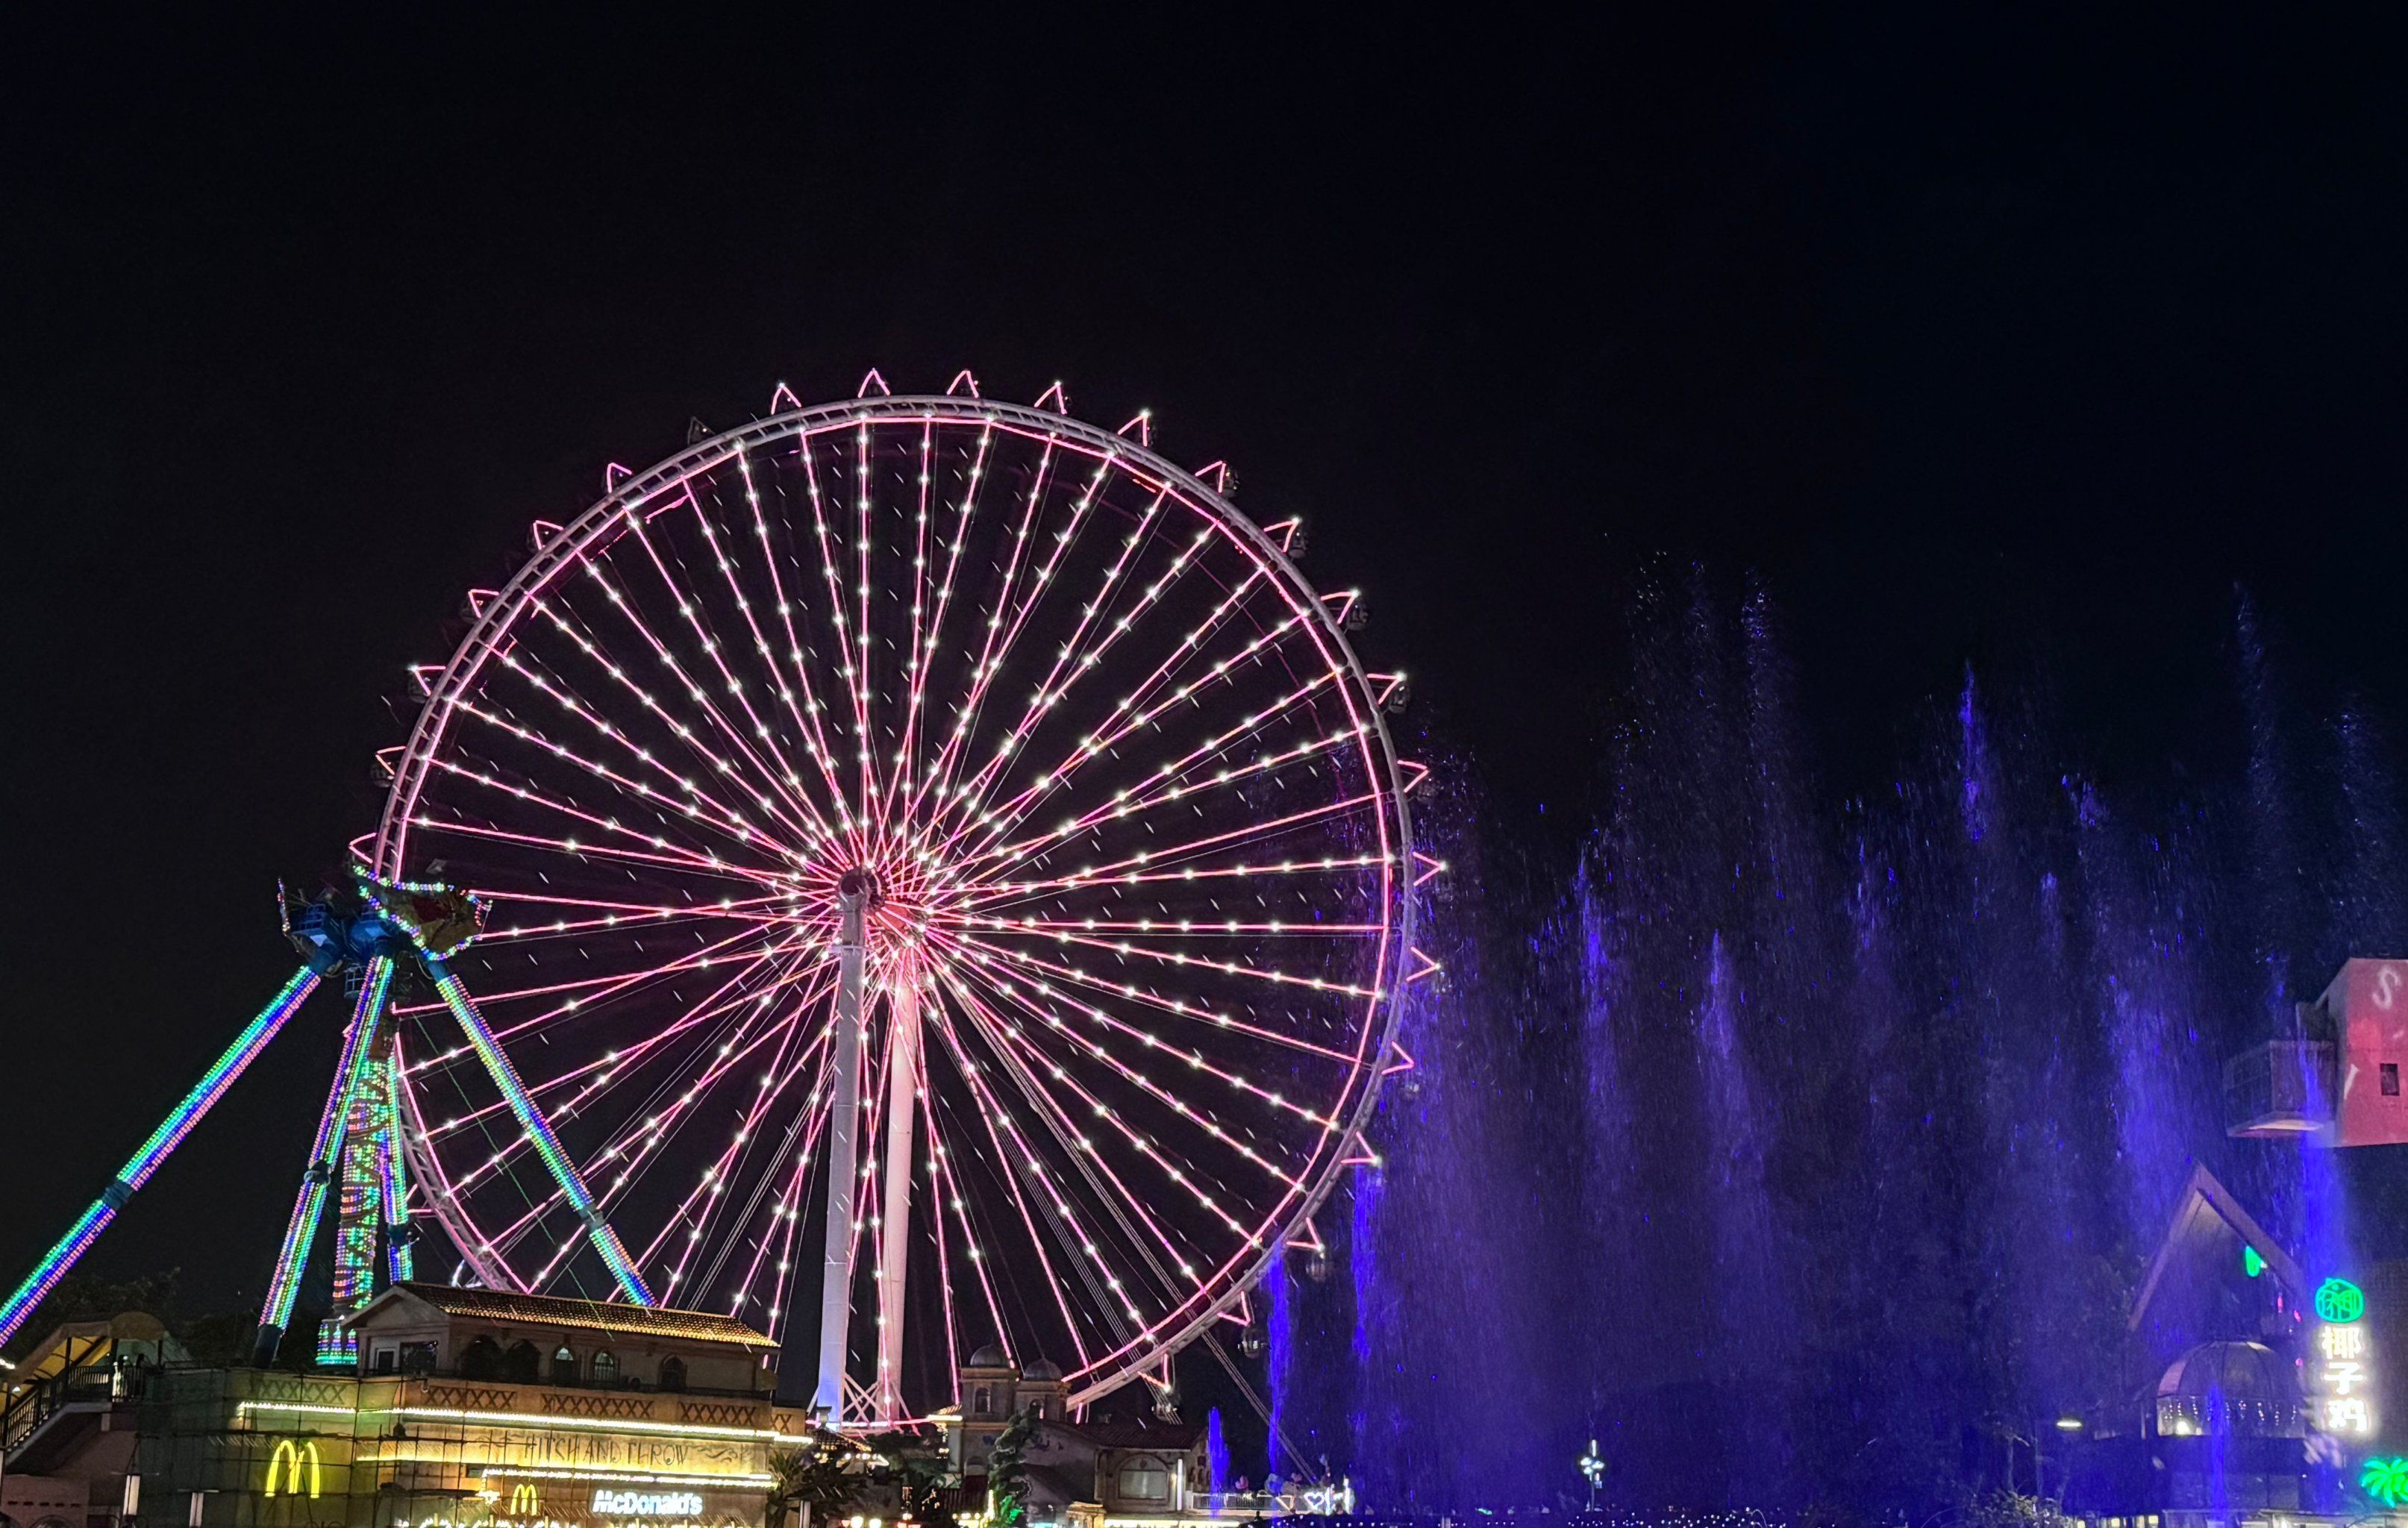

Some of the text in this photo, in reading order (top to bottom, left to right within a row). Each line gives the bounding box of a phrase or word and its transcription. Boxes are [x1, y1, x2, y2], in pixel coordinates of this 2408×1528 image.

[2320, 1326, 2368, 1432] 椰子鸡
[583, 1437, 622, 1464] AND
[627, 1441, 689, 1466] THROW
[592, 1490, 703, 1515] McDonald's
